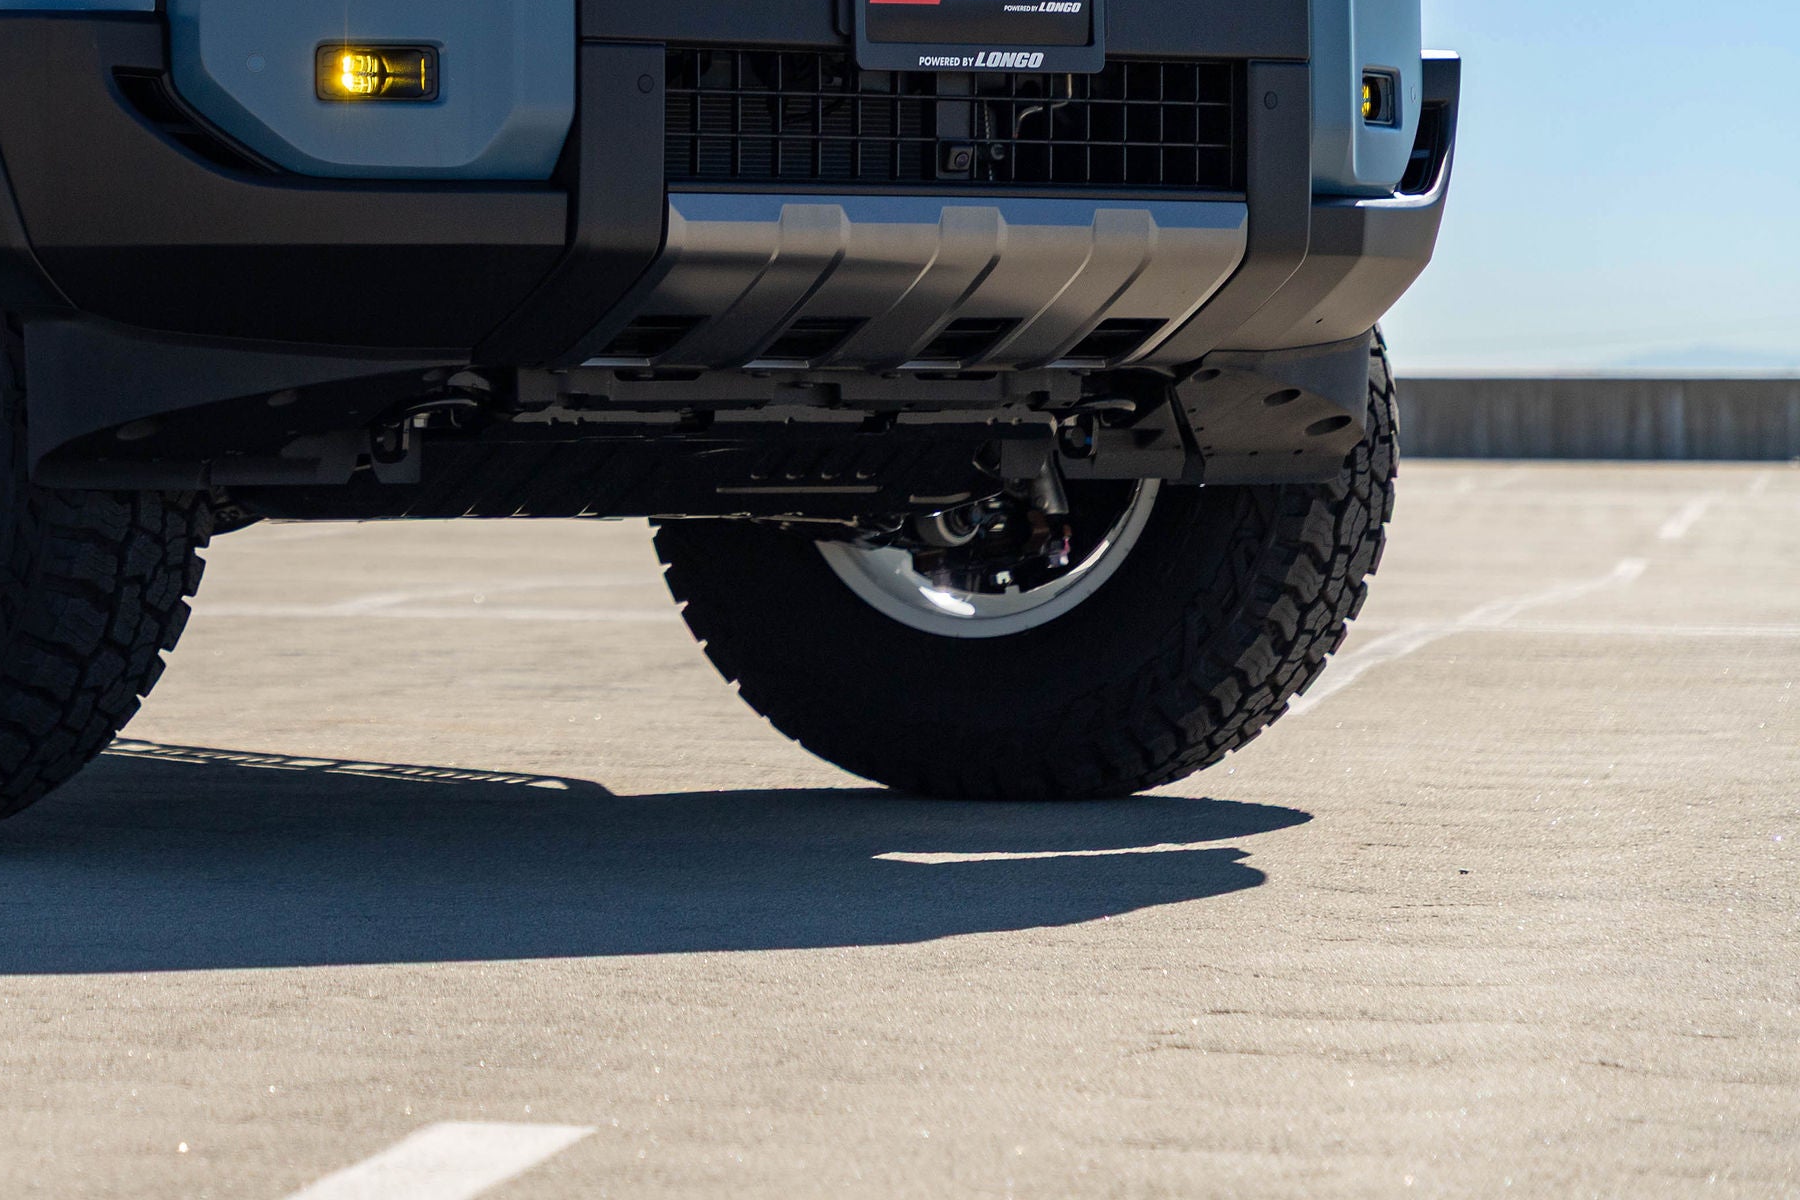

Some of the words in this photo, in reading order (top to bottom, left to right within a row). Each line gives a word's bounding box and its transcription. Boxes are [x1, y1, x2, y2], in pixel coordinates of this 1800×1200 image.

[1038, 2, 1082, 13] LONGO
[919, 56, 961, 67] POWERED
[962, 57, 974, 67] BY
[974, 51, 1044, 68] LONGO
